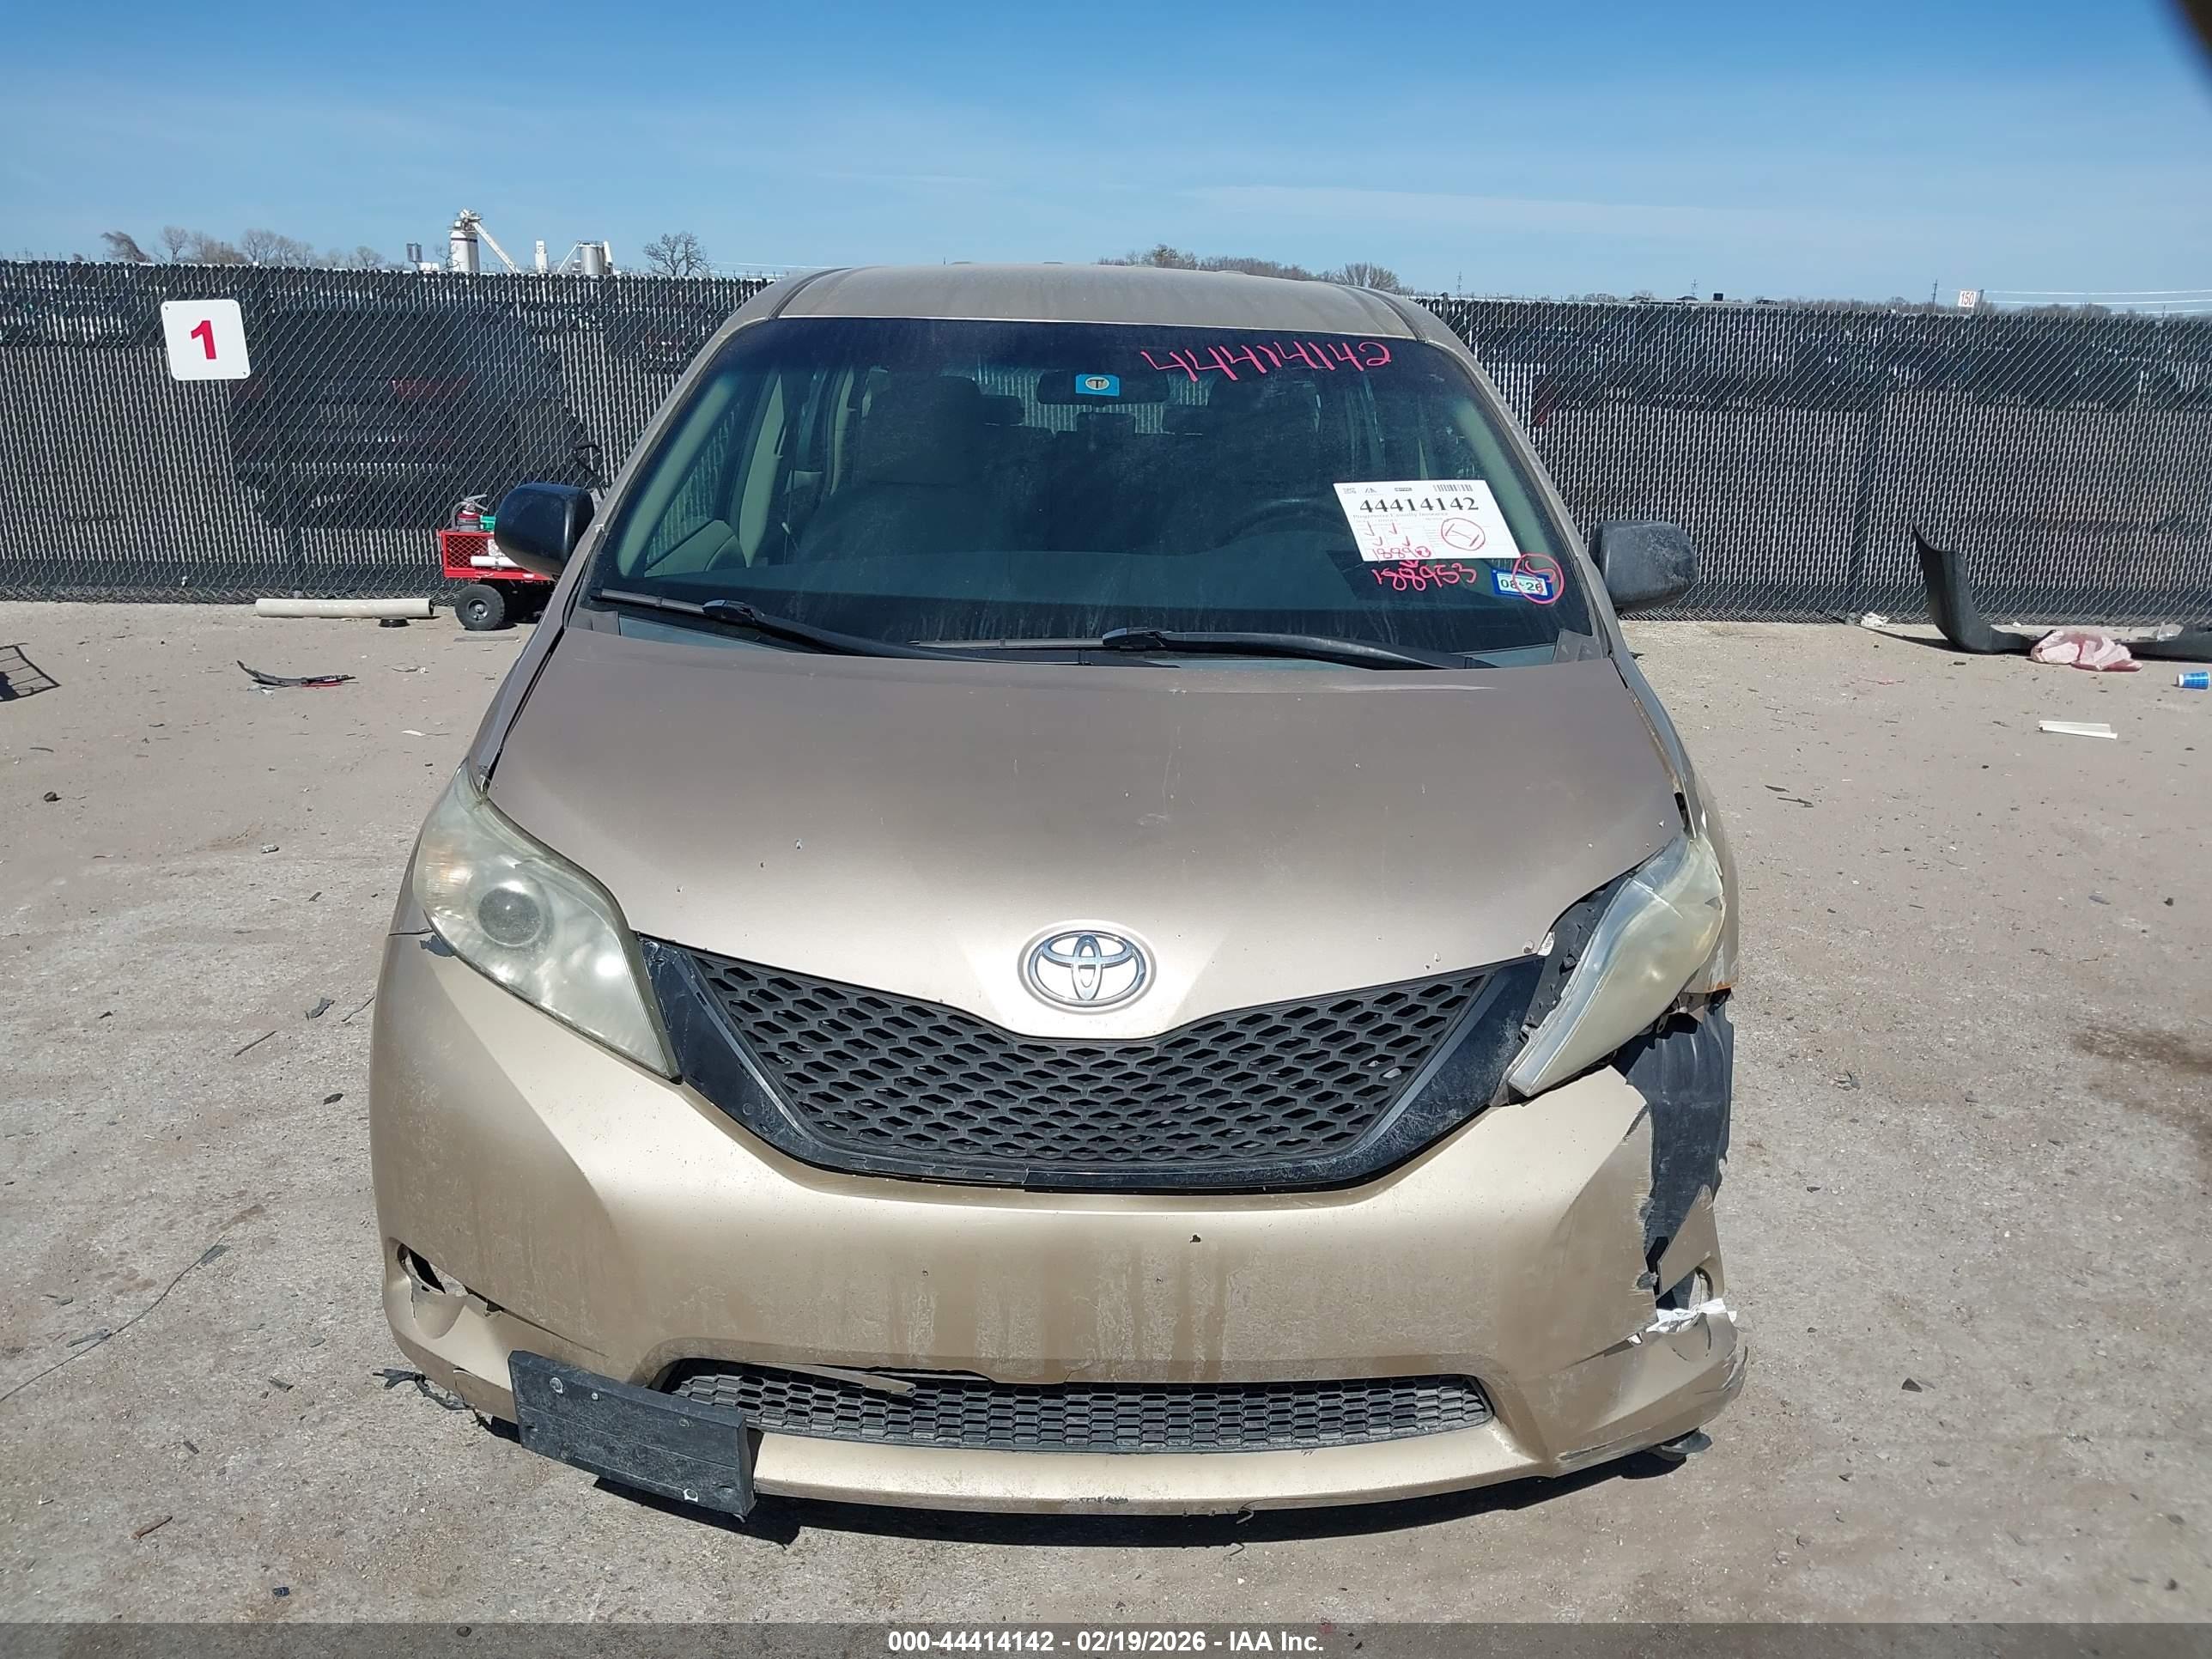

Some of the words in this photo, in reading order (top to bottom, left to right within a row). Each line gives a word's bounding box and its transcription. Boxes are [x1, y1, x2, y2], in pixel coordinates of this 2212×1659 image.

[1960, 292, 1974, 306] 150
[191, 319, 217, 360] 1
[1140, 341, 1392, 383] 44414142
[1360, 497, 1480, 513] 44414142
[1500, 579, 1544, 594] 08-26
